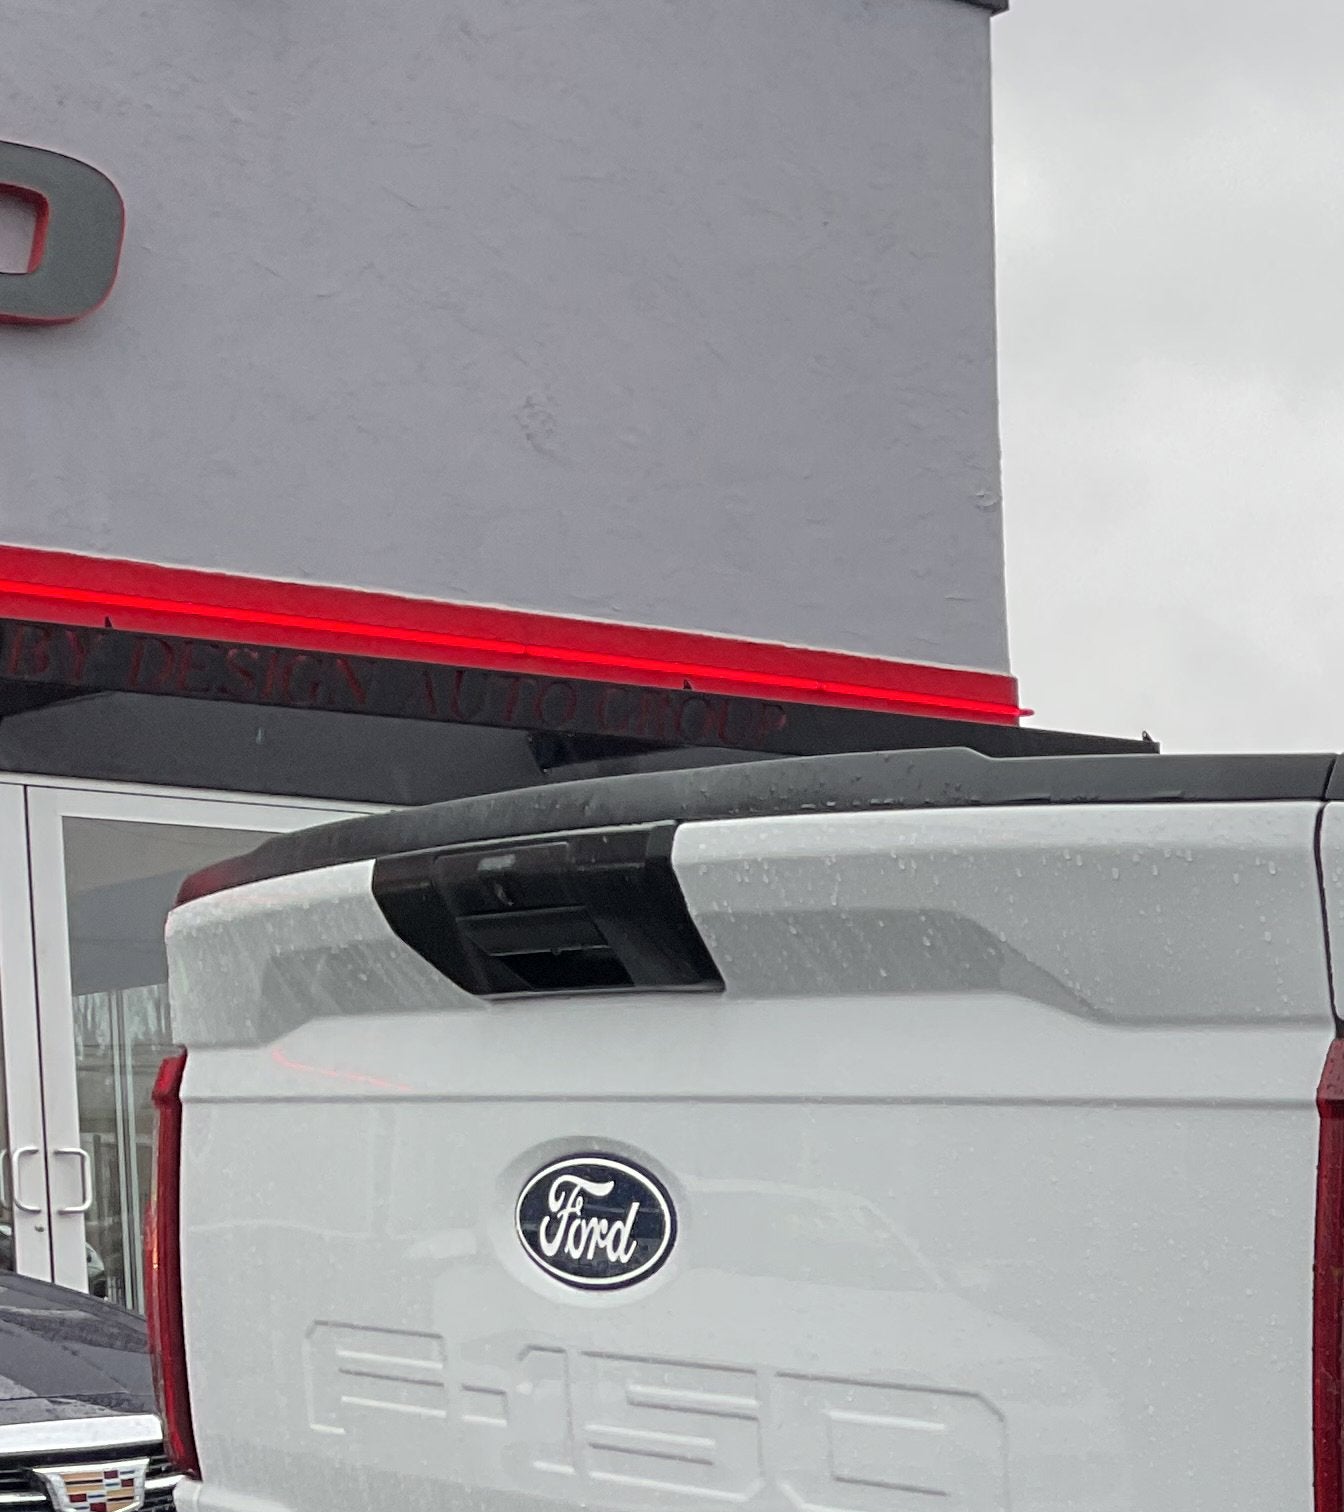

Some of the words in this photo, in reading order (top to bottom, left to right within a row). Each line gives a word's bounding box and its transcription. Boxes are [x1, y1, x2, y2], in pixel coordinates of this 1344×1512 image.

[4, 622, 107, 682] BY
[127, 634, 384, 708] DESIGN
[539, 1174, 641, 1264] Ford
